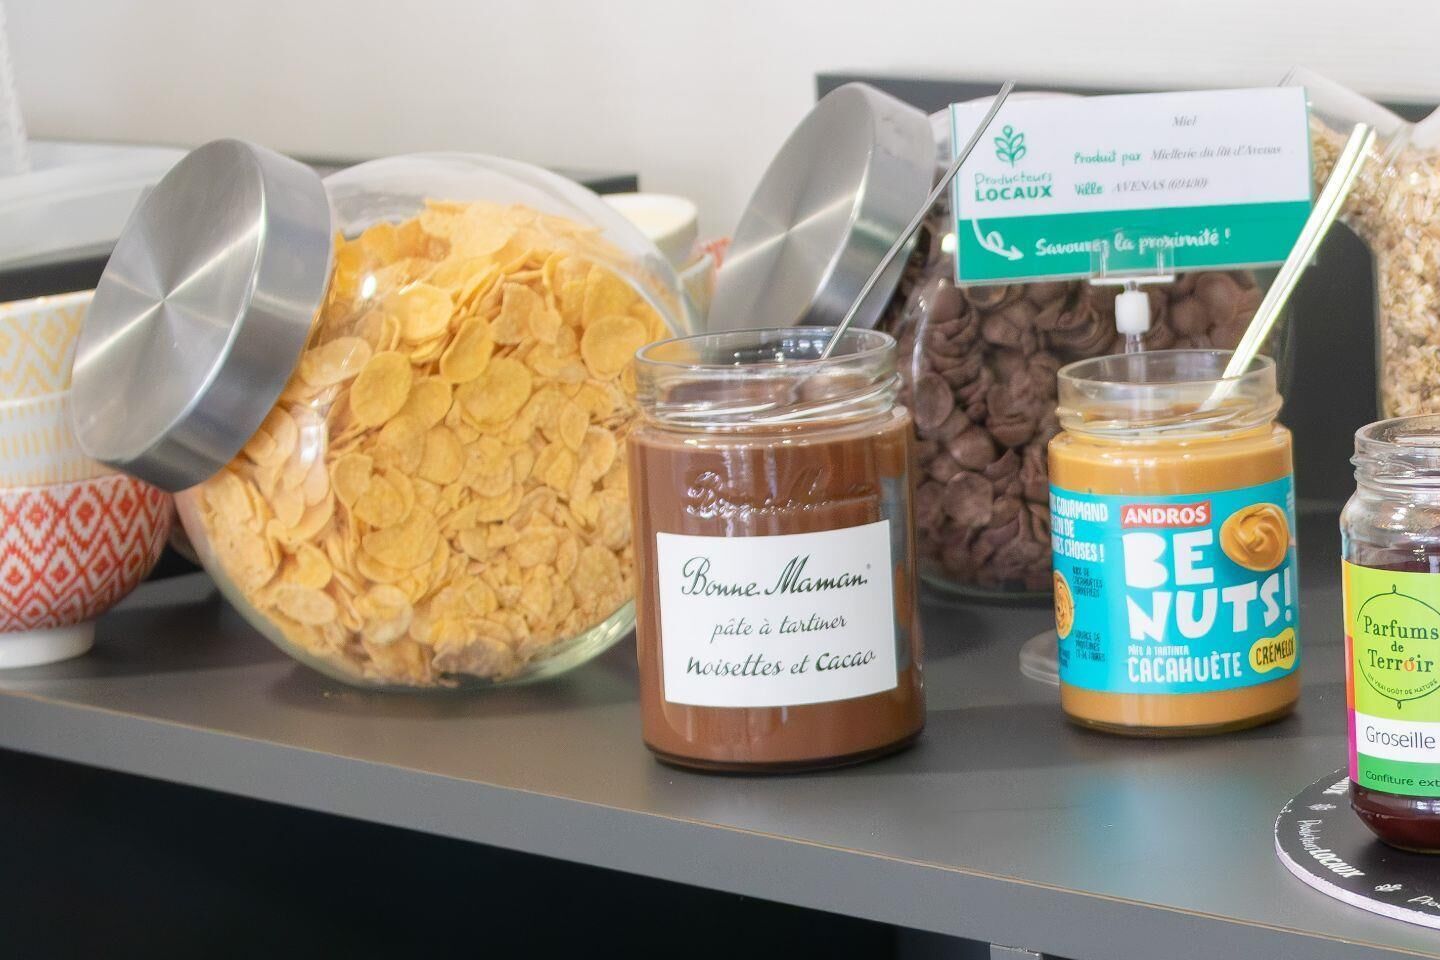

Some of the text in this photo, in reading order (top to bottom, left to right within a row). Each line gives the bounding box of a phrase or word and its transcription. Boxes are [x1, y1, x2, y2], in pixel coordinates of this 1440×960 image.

[1172, 115, 1198, 128] Miel
[1074, 149, 1117, 165] Produit
[1121, 153, 1142, 167] par
[974, 171, 1053, 187] Producteurs
[1075, 182, 1103, 196] Ville
[975, 185, 1053, 202] LOCAUX
[1035, 237, 1110, 260] Savourez
[1114, 232, 1135, 252] la
[1138, 228, 1219, 255] proximité
[1056, 497, 1109, 522] GOURMAND
[1123, 505, 1207, 525] ANDROS
[1122, 529, 1214, 589] BE
[681, 556, 761, 597] Bonne
[1126, 567, 1293, 643] NUTS!
[710, 612, 848, 644] pâte à tartiner
[1363, 615, 1440, 640] Parfums
[1391, 640, 1404, 653] de
[790, 654, 810, 675] et
[815, 649, 877, 672] Cacao
[1128, 651, 1243, 683] CACAHUÈTE
[1367, 648, 1434, 672] Terroir
[1365, 726, 1436, 749] Groseille
[1365, 770, 1414, 787] Confiture
